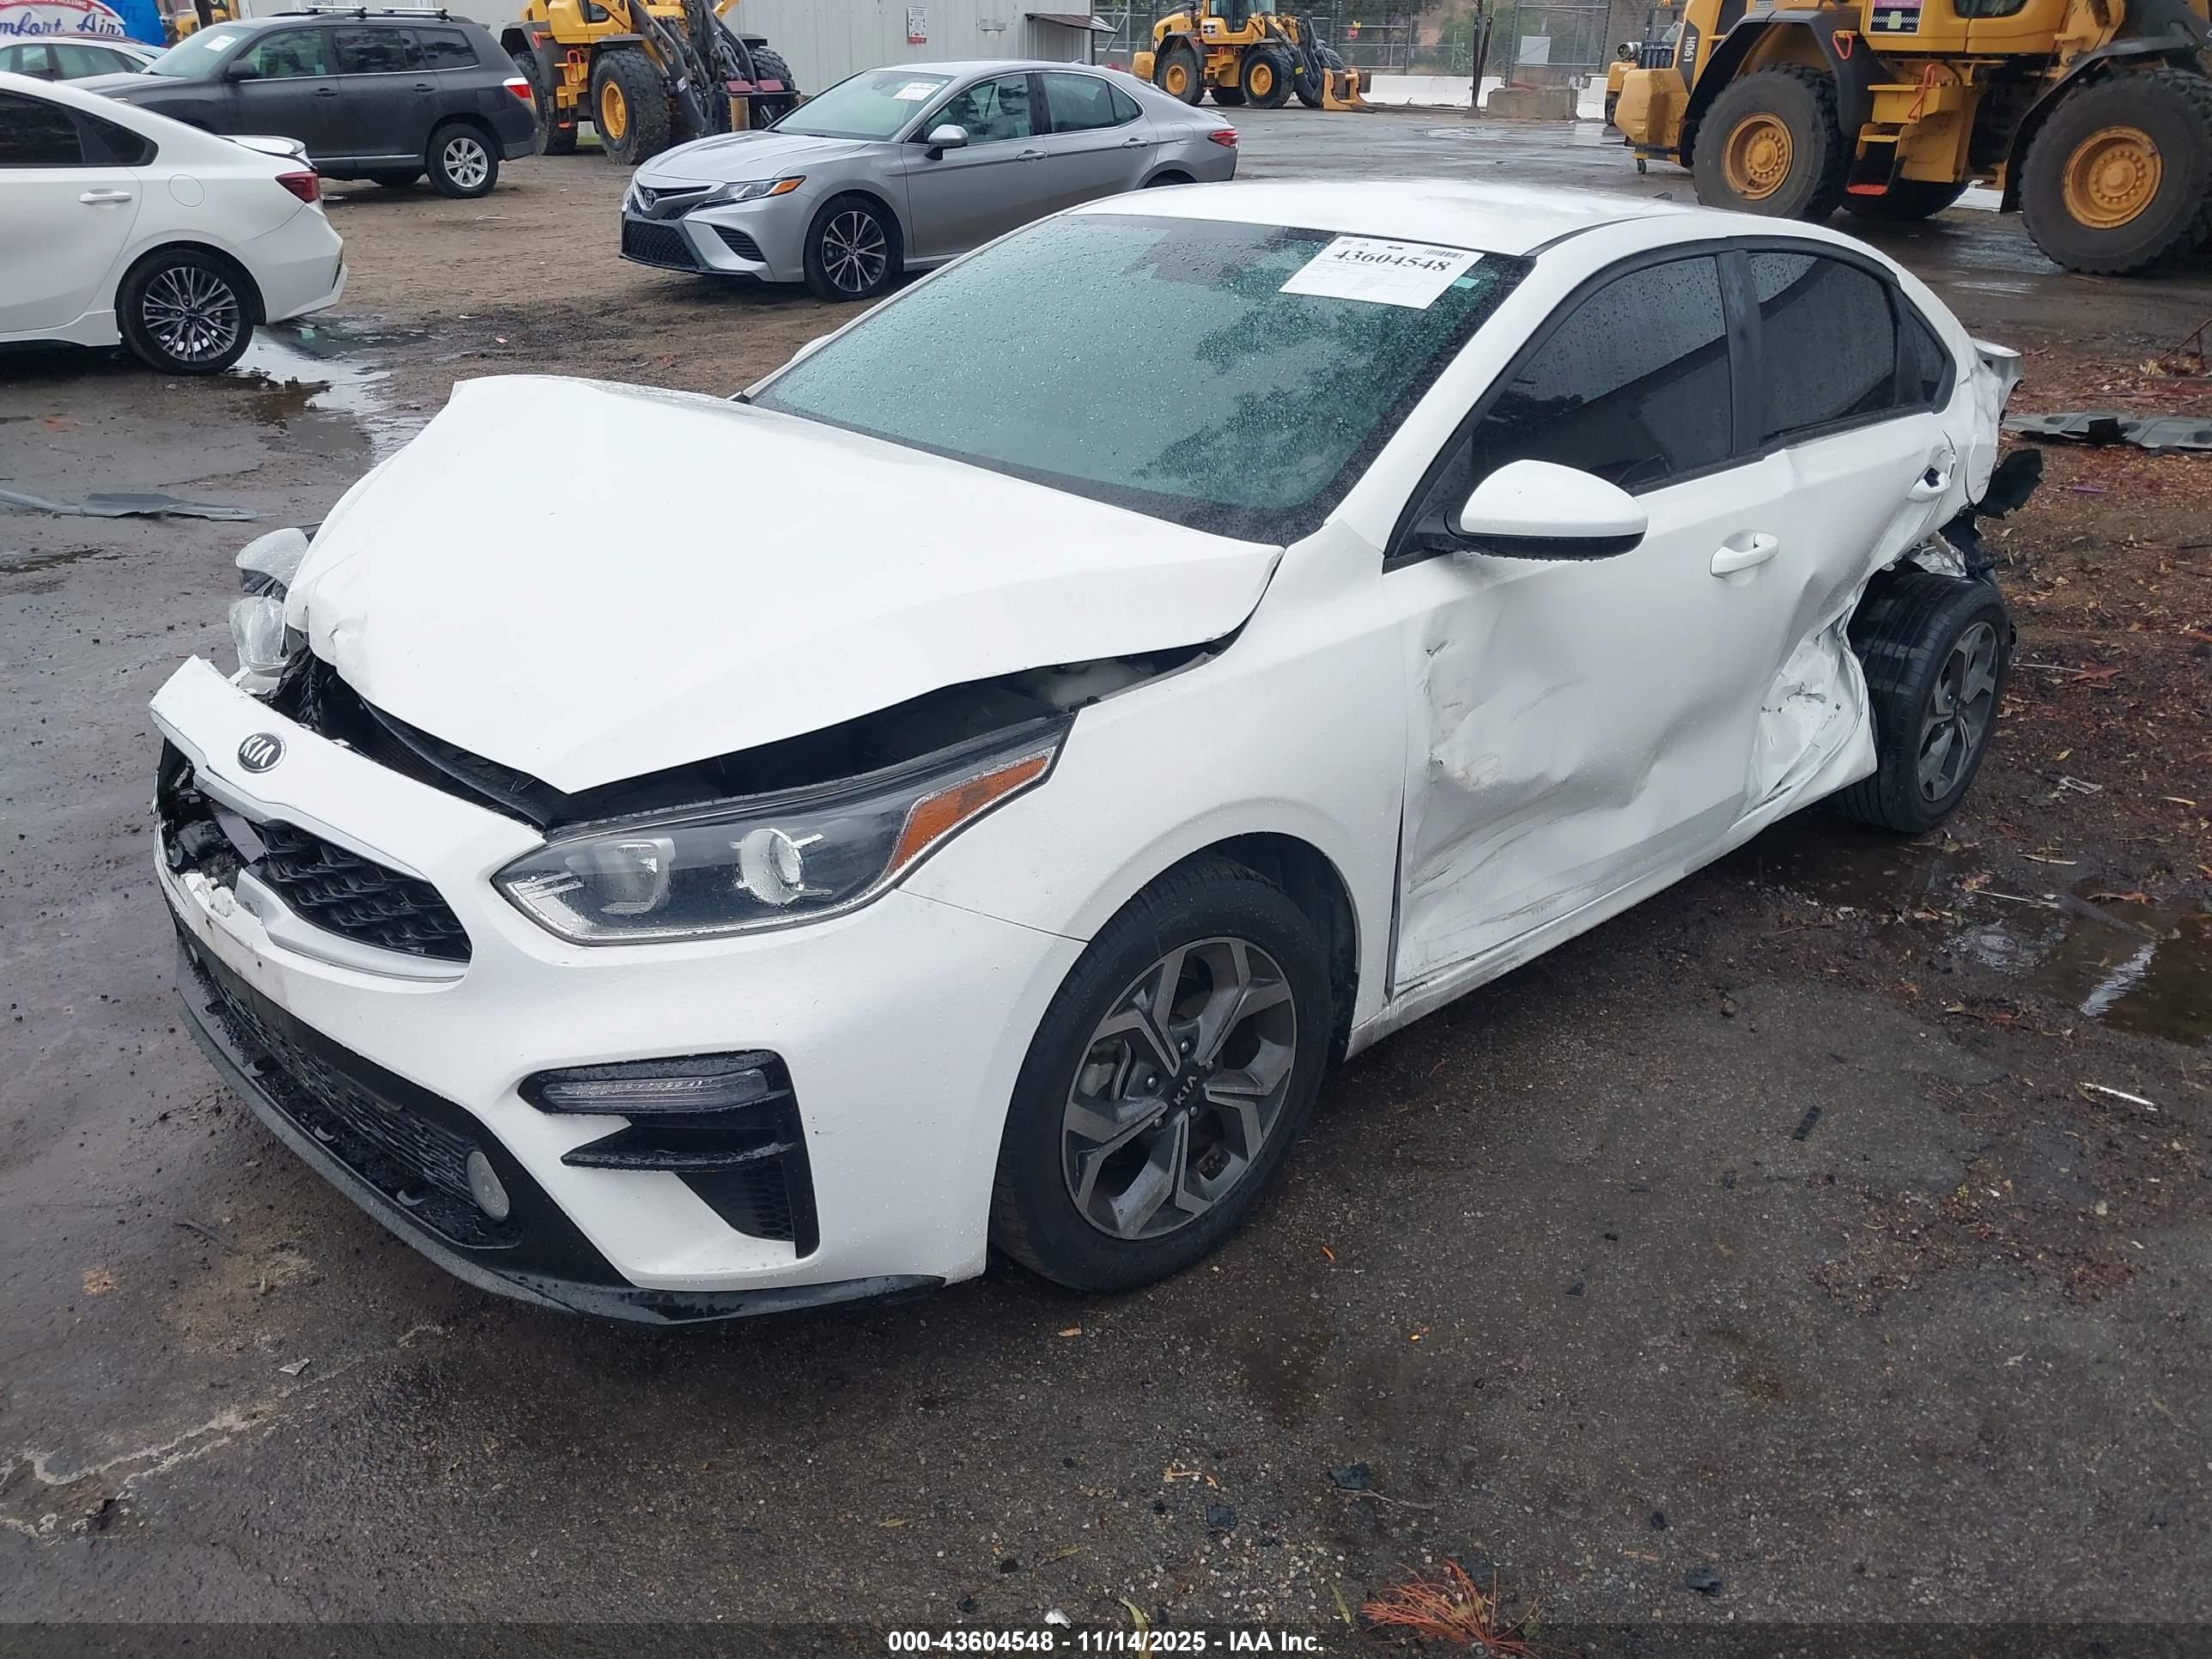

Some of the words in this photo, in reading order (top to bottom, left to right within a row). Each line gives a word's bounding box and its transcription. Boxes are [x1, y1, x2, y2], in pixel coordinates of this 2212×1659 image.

[76, 13, 120, 35] Air
[1682, 36, 1697, 63] L90H
[1334, 250, 1451, 271] 43604548
[240, 734, 276, 768] KIA
[1173, 1075, 1198, 1106] KIA
